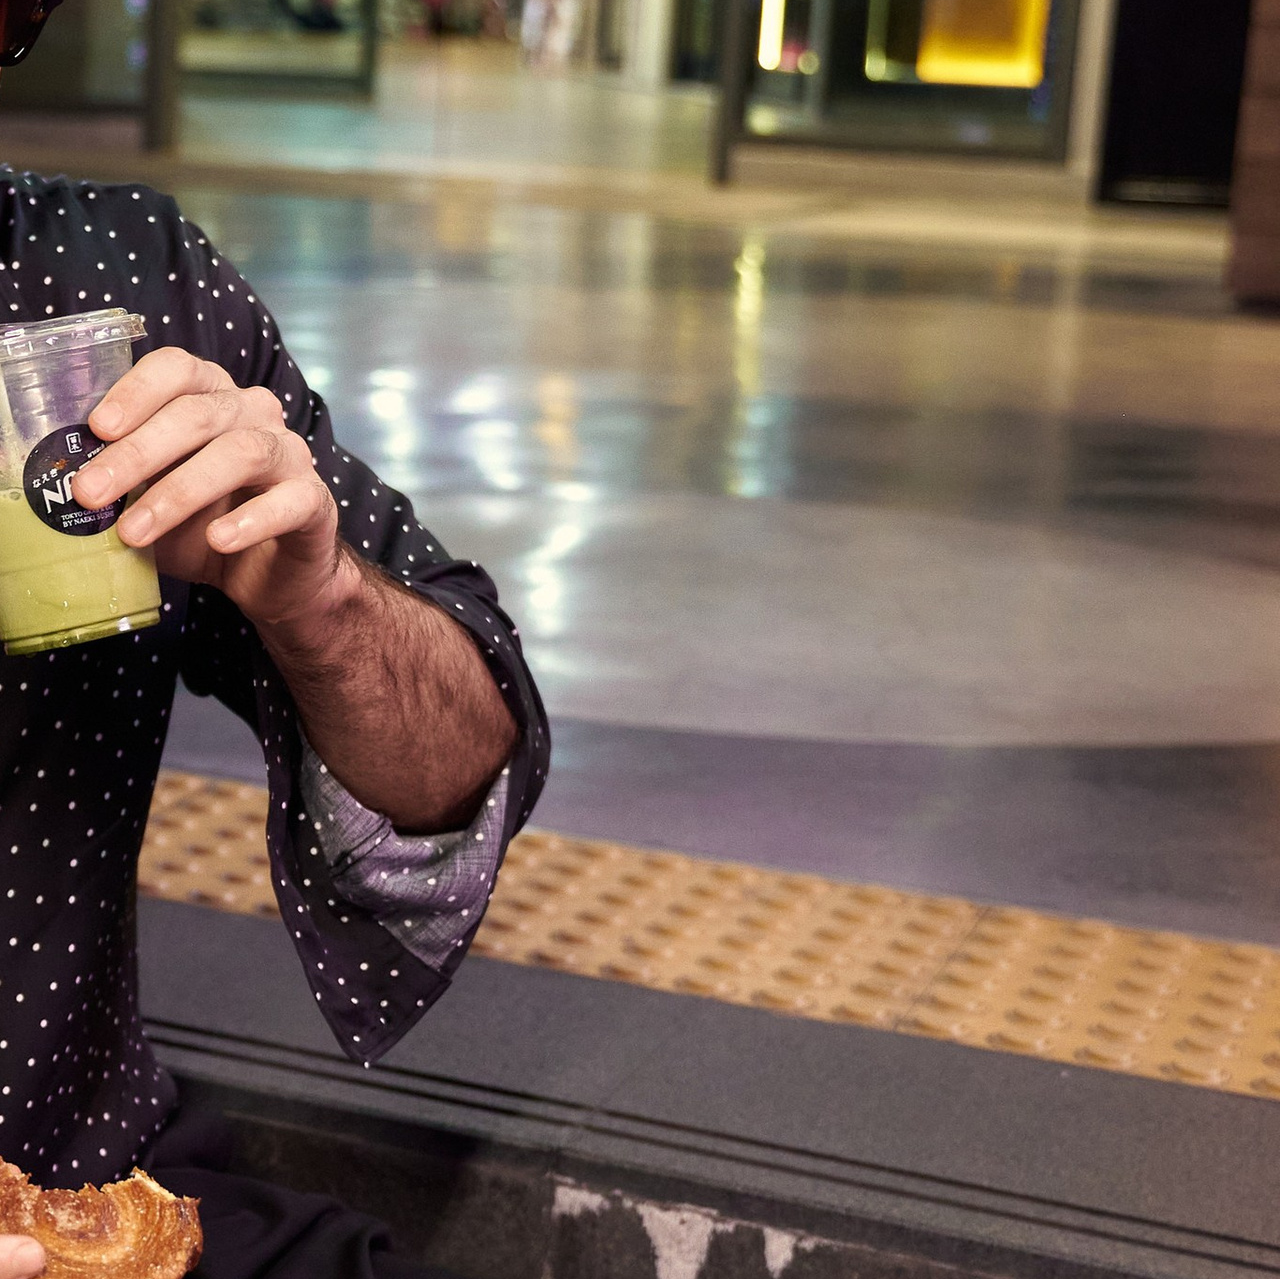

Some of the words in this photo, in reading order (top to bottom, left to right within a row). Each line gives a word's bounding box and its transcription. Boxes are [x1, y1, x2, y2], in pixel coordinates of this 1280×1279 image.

[61, 511, 83, 520] TOKYO
[62, 519, 73, 528] BY
[73, 515, 96, 525] NAEKI
